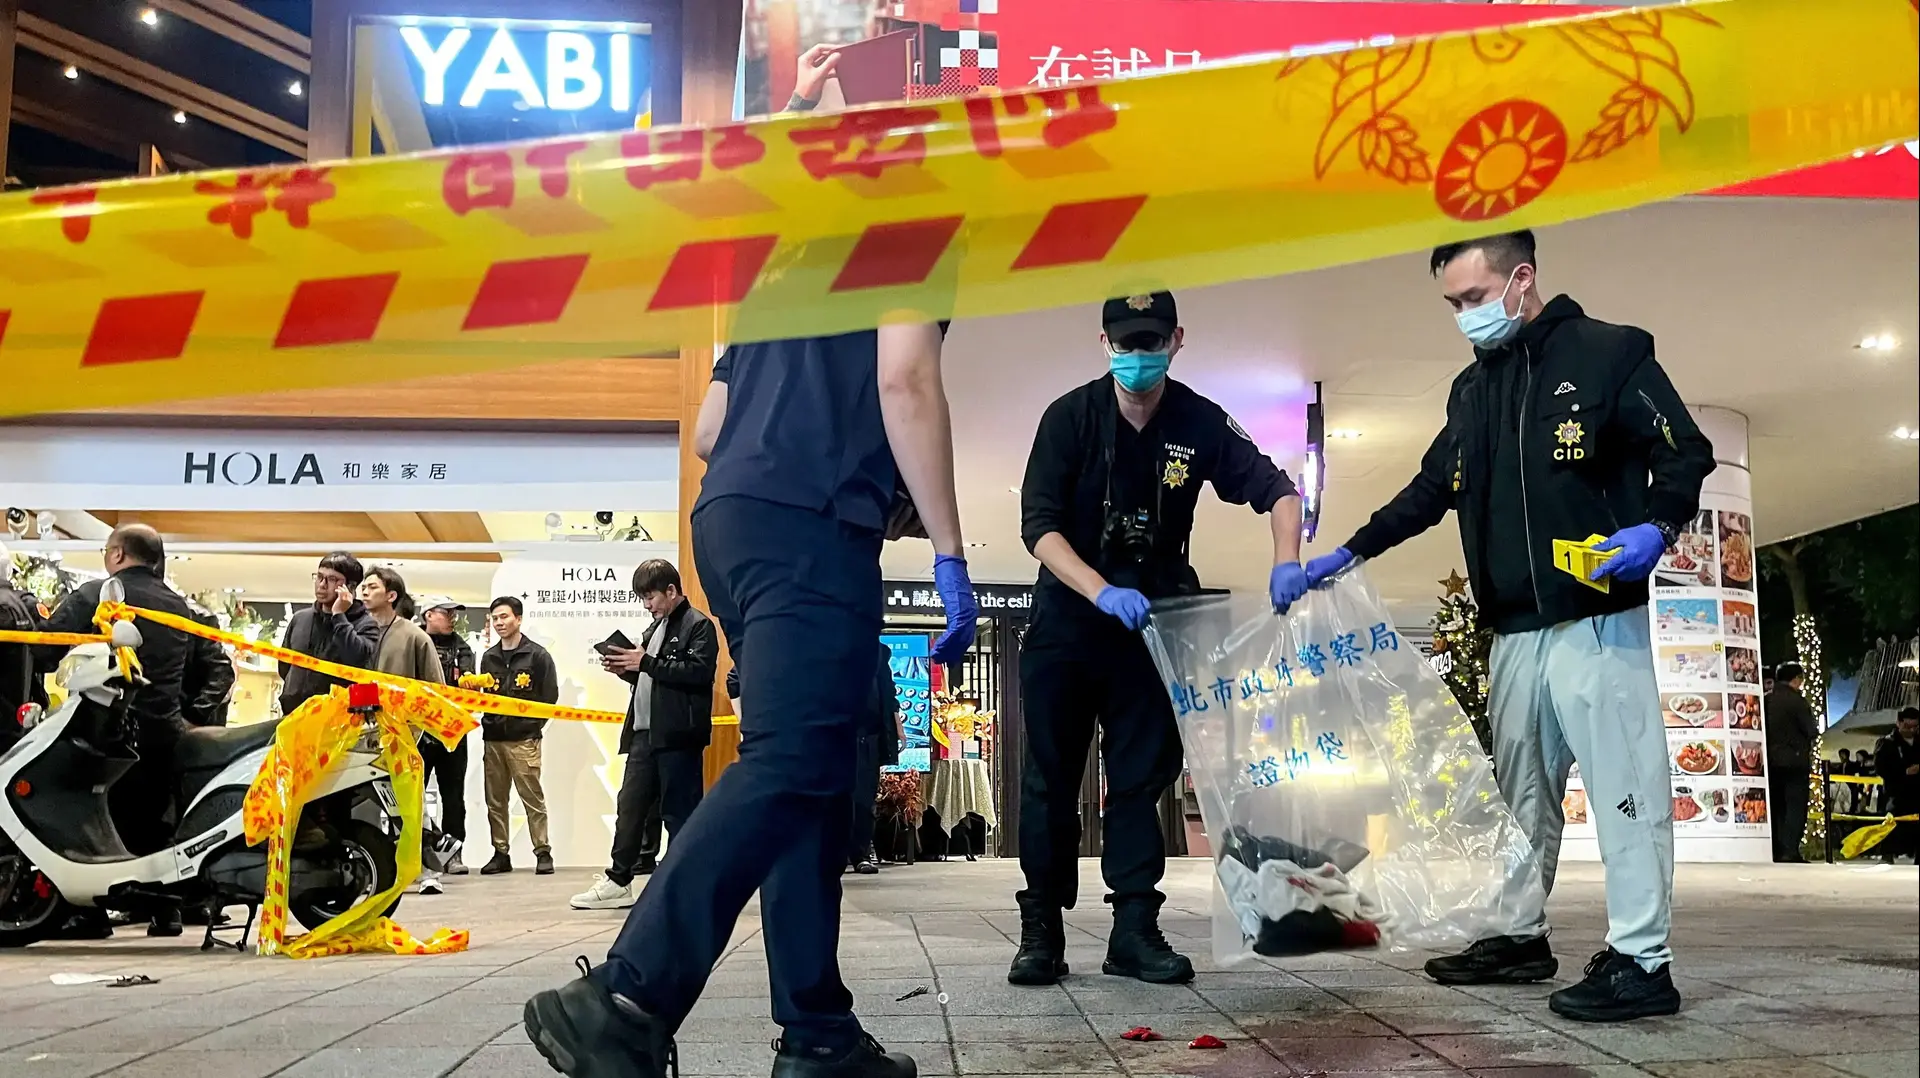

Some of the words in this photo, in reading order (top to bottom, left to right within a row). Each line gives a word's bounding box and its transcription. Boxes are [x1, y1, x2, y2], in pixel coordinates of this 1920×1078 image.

[400, 27, 631, 112] YABI
[1553, 448, 1585, 460] CID
[184, 452, 325, 485] HOLA
[342, 463, 447, 480] 和樂家居
[1564, 551, 1571, 571] 1
[562, 568, 617, 581] HOLA
[980, 592, 1005, 607] the
[1008, 592, 1032, 608] esli
[1171, 622, 1399, 717] 北市政府警察局
